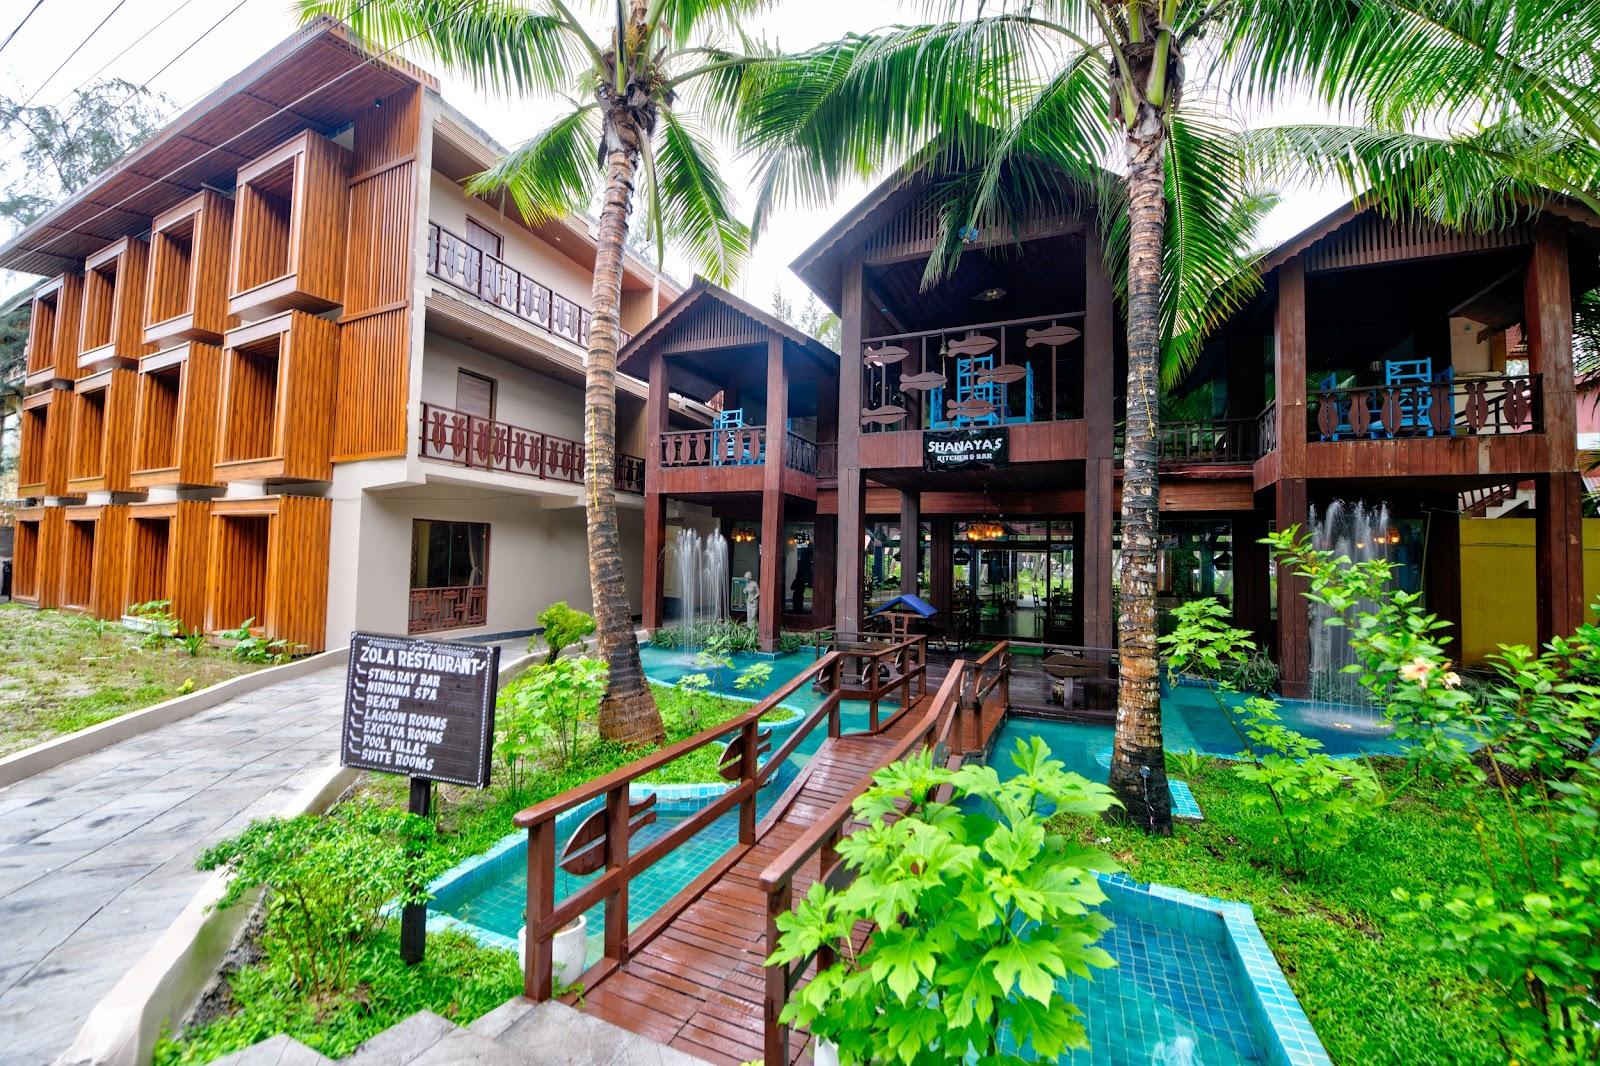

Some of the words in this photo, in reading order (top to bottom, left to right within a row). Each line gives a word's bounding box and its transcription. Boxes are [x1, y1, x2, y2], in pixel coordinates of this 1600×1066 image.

[937, 454, 968, 463] KITCHEN
[360, 647, 395, 665] ZOLA
[398, 651, 480, 675] RESTAURANT
[420, 674, 440, 687] BAR
[366, 681, 410, 697] NIRVANA
[414, 687, 437, 700] SPA
[366, 694, 399, 709] BEACH
[364, 708, 406, 724] LAGOON
[409, 713, 448, 730] ROOMS
[363, 722, 405, 738] EXOTICA
[408, 728, 443, 744] ROOMS
[362, 736, 387, 749] POOL
[391, 740, 427, 755] VILLAS
[361, 749, 391, 764] SUITE
[395, 754, 434, 771] ROOMS
